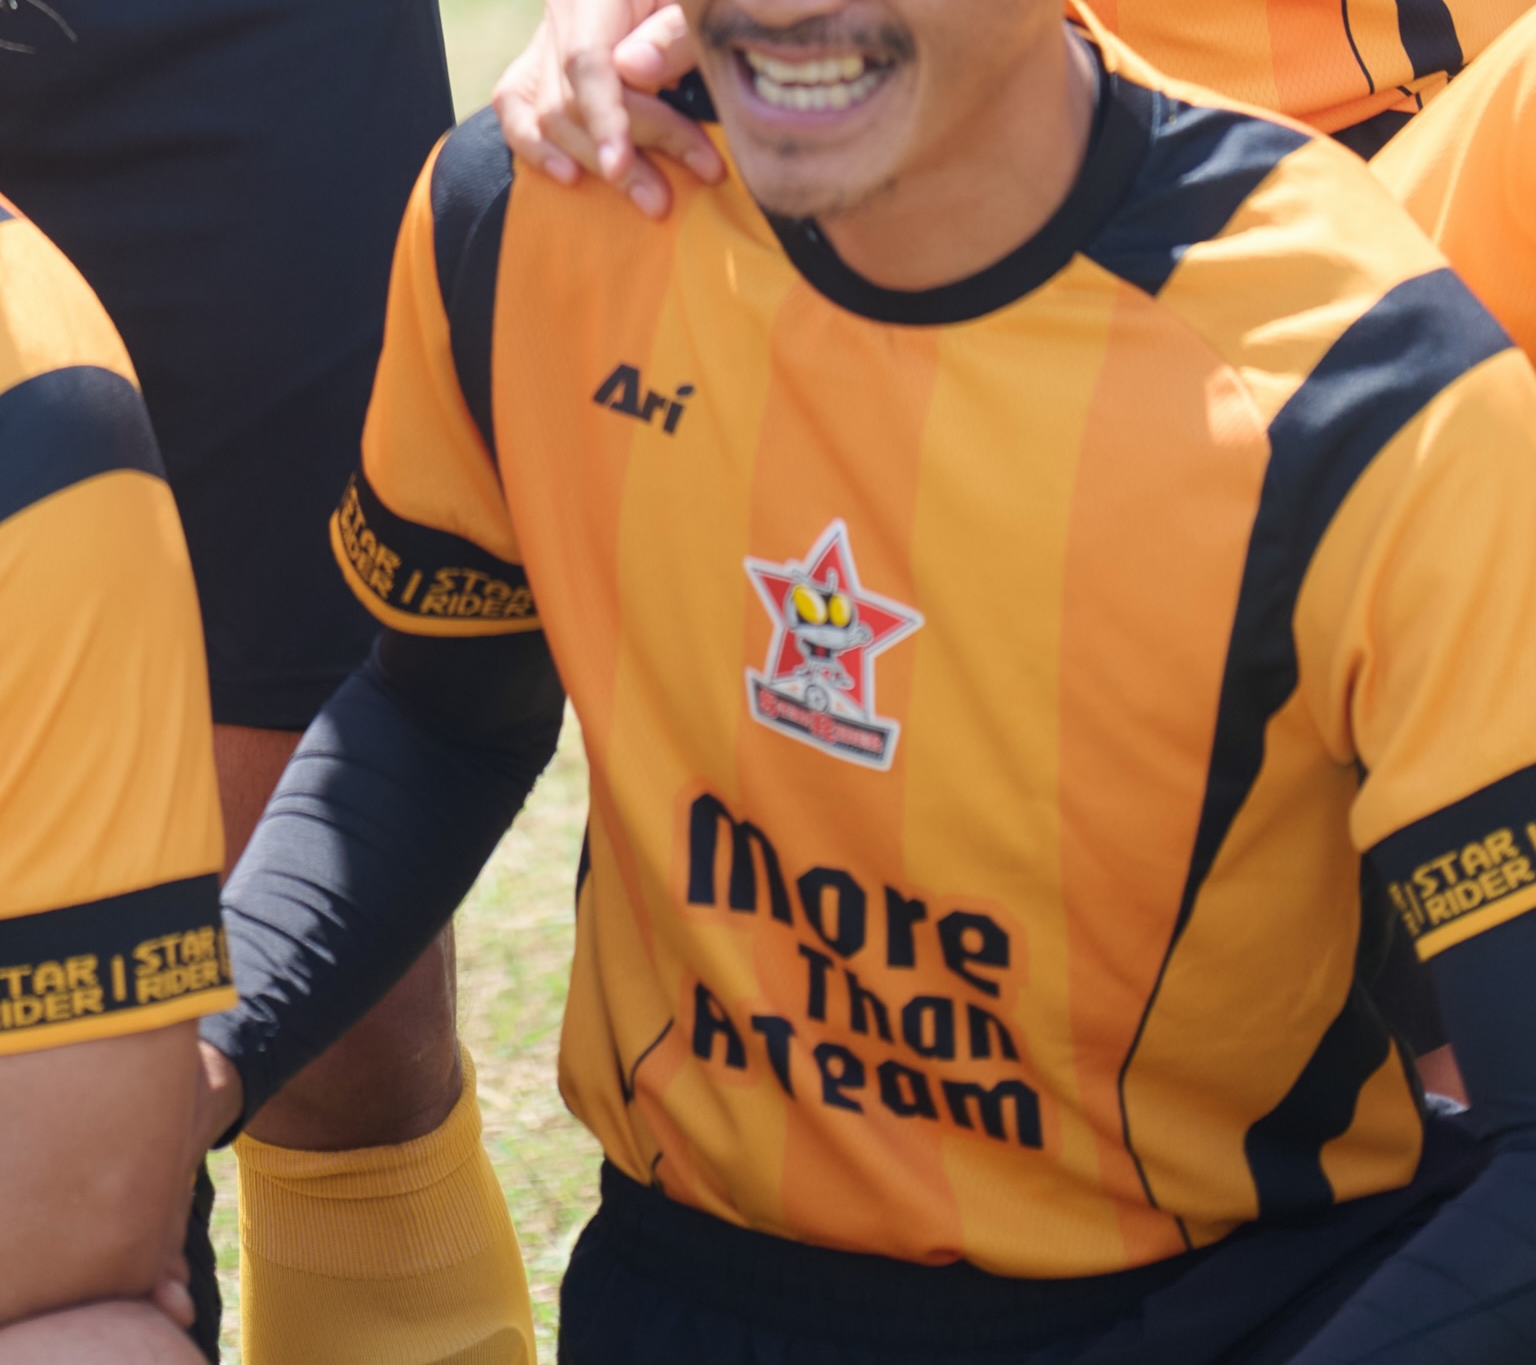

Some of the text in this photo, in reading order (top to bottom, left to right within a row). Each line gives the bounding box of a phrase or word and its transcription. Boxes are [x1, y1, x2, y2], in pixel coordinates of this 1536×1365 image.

[594, 365, 694, 434] Ari
[688, 793, 1010, 999] More
[1412, 827, 1520, 900] STAR
[1425, 856, 1535, 926] RIDER
[132, 924, 216, 977] STAR
[135, 960, 220, 1005] RIDER
[797, 942, 1020, 1062] Than
[692, 981, 1044, 1150] A Team
